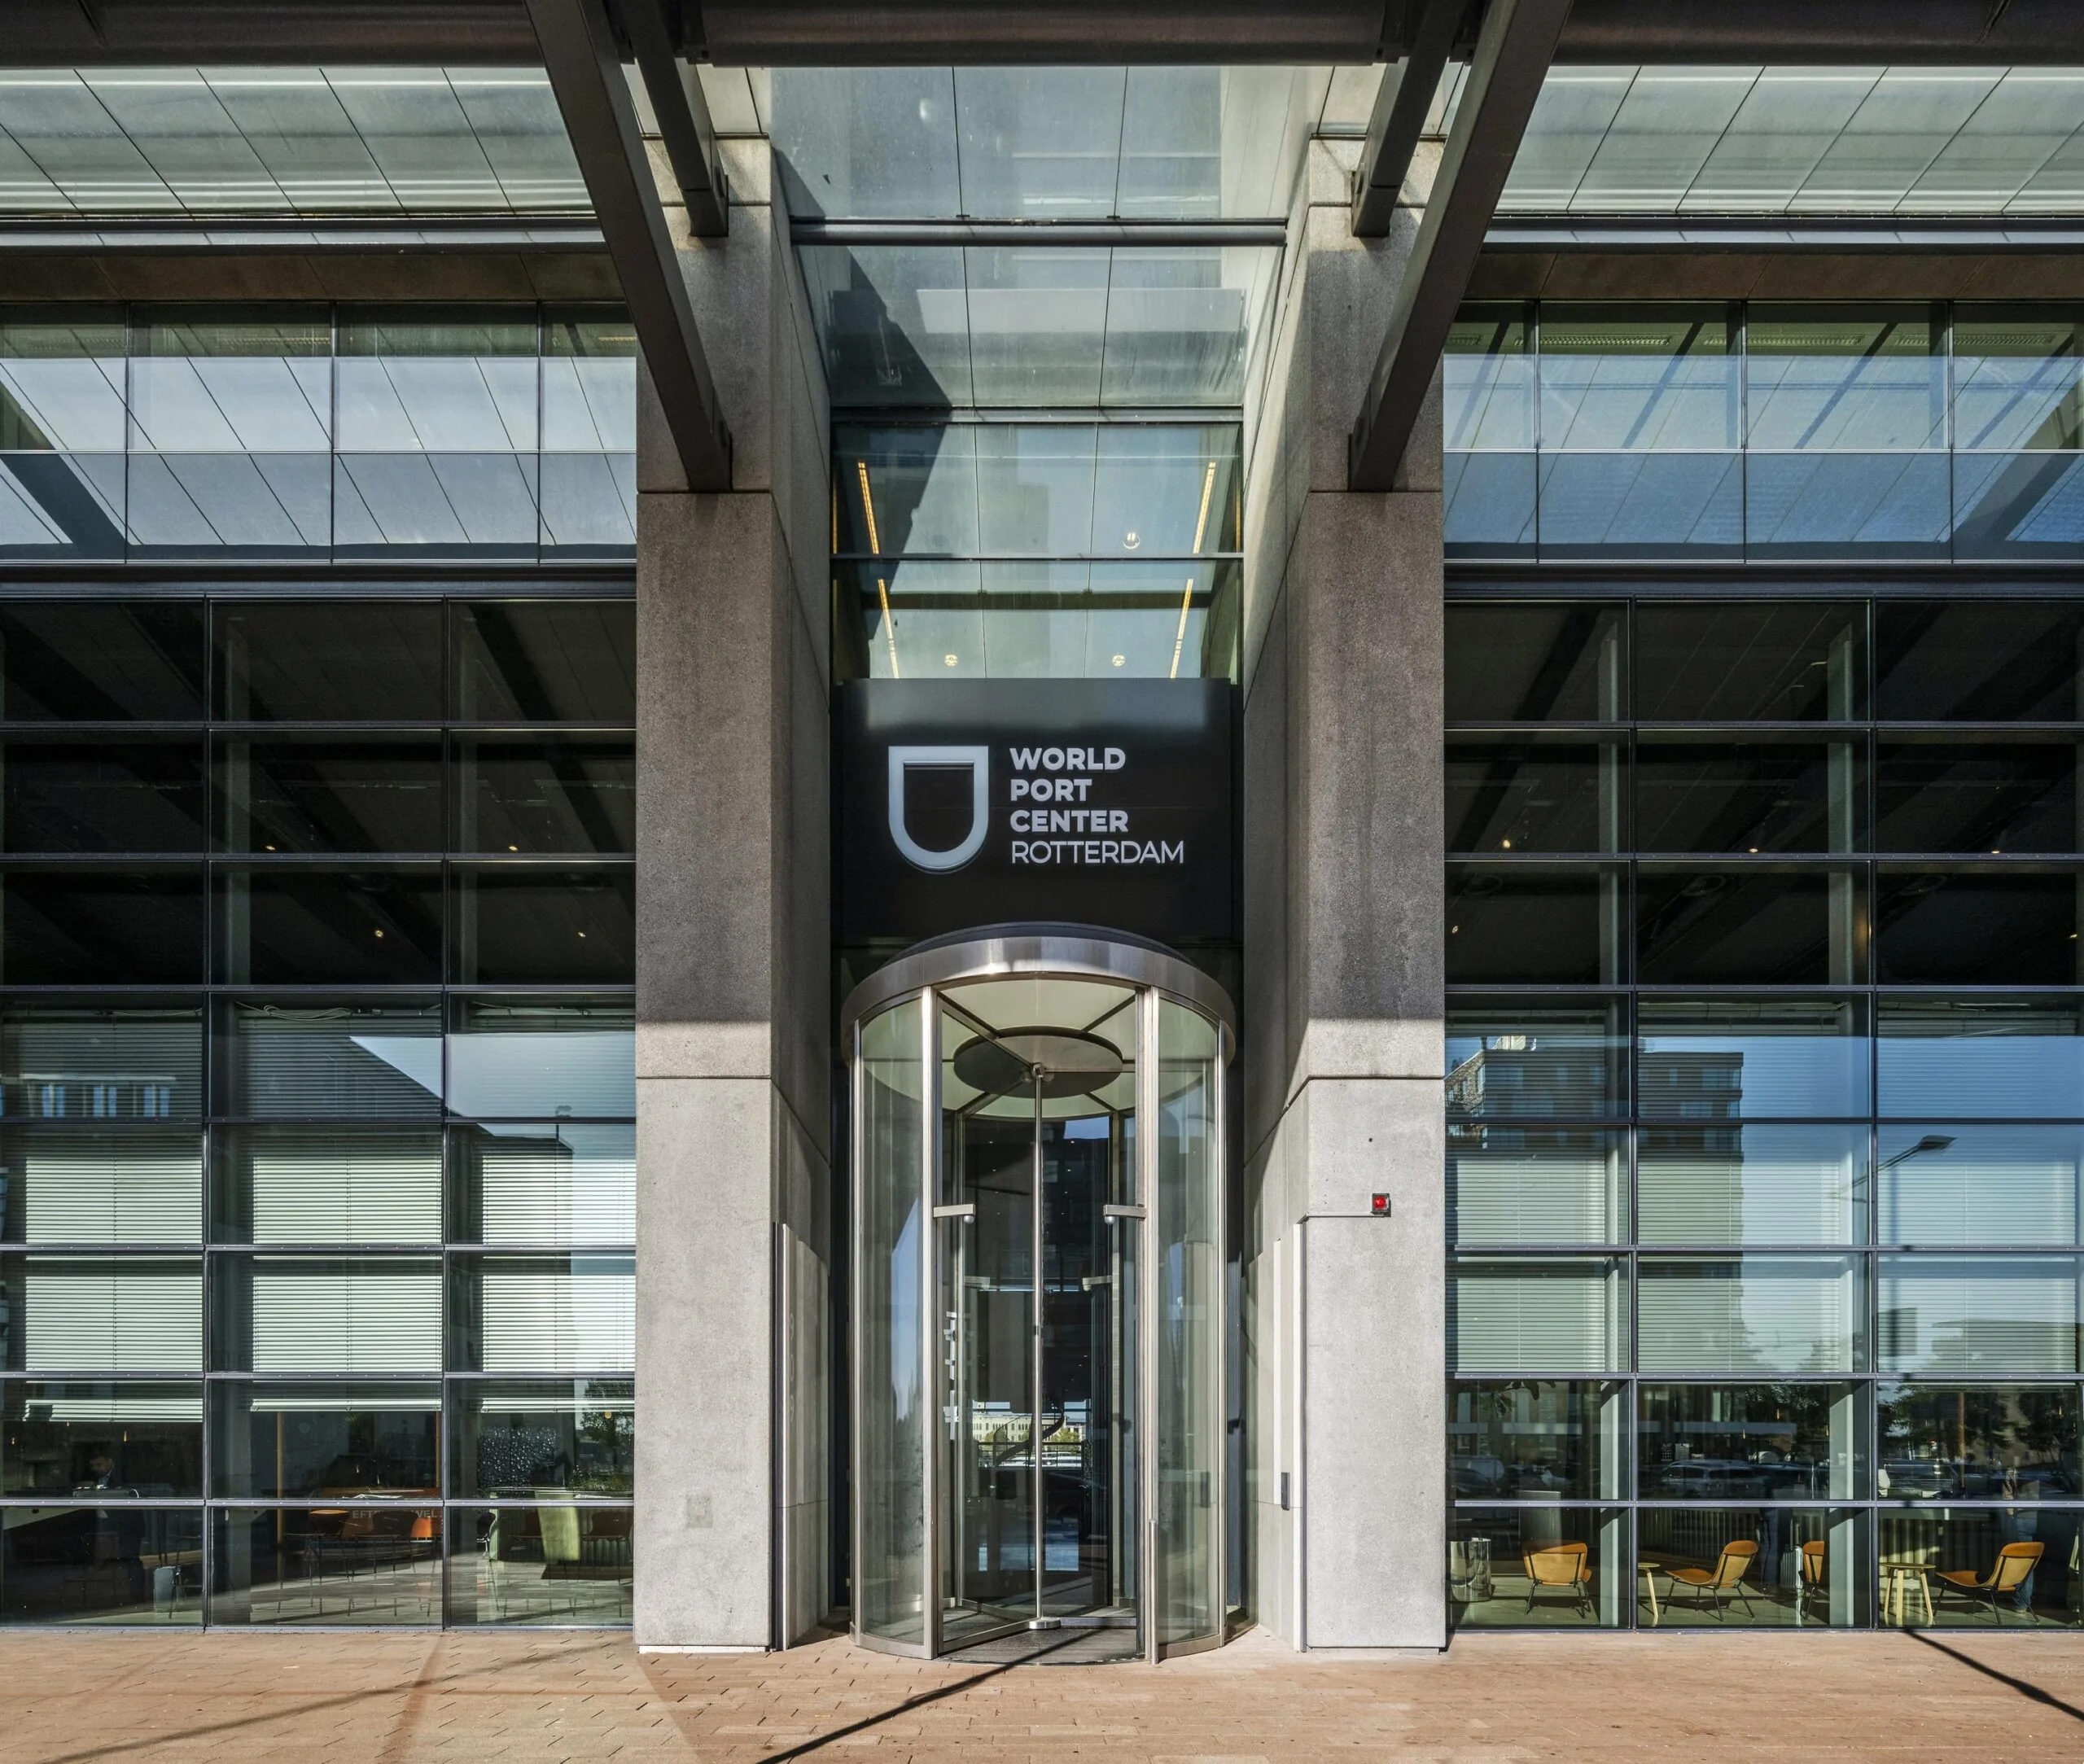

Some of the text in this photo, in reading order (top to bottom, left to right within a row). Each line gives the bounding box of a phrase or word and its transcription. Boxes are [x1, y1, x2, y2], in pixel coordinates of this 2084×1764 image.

[1009, 747, 1126, 770] WORLD
[1010, 778, 1092, 802] PORT
[1009, 810, 1129, 833] CENTER
[1012, 840, 1184, 864] ROTTERDAM
